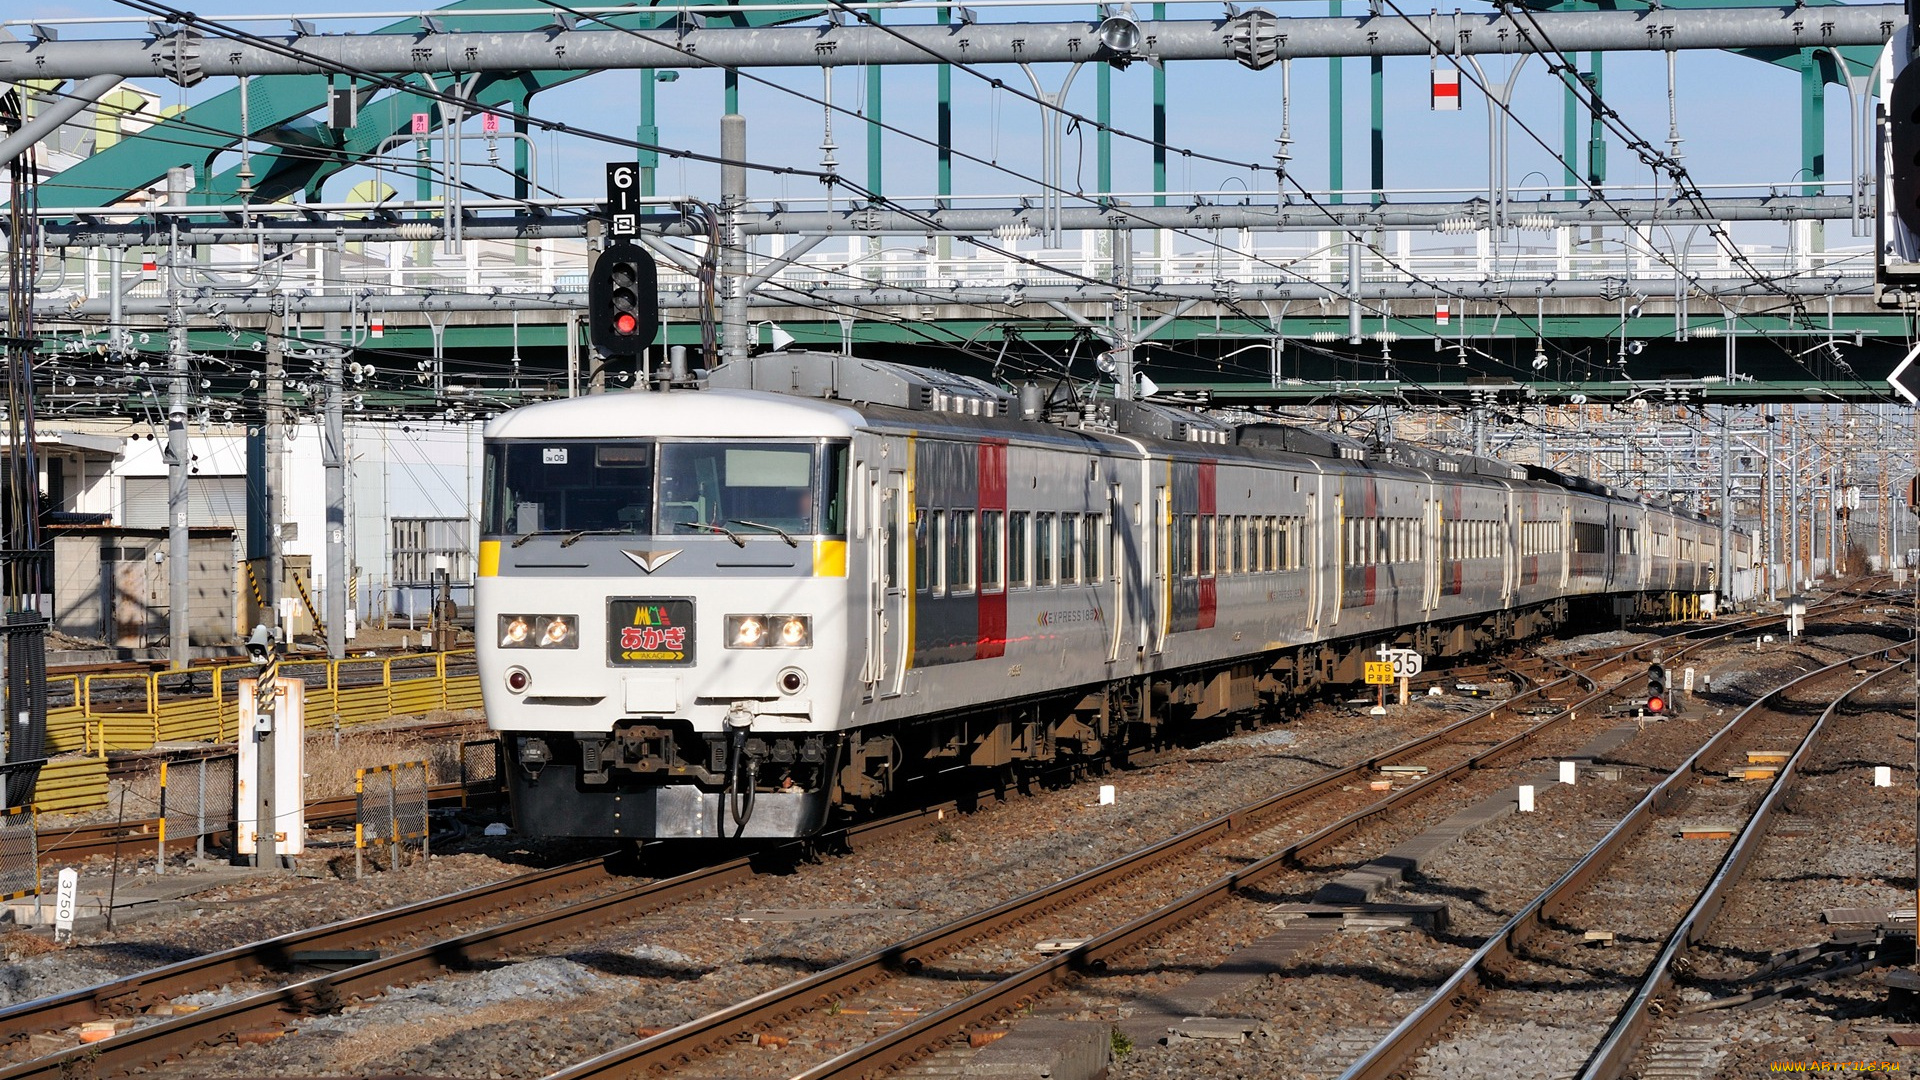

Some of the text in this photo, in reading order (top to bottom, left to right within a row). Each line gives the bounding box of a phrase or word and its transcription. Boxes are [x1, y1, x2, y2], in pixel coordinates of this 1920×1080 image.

[487, 121, 495, 129] 22
[614, 167, 632, 188] 6
[554, 454, 564, 462] 09
[621, 627, 686, 650] あかぎ
[1368, 664, 1391, 672] ATS
[60, 880, 72, 919] 3750
